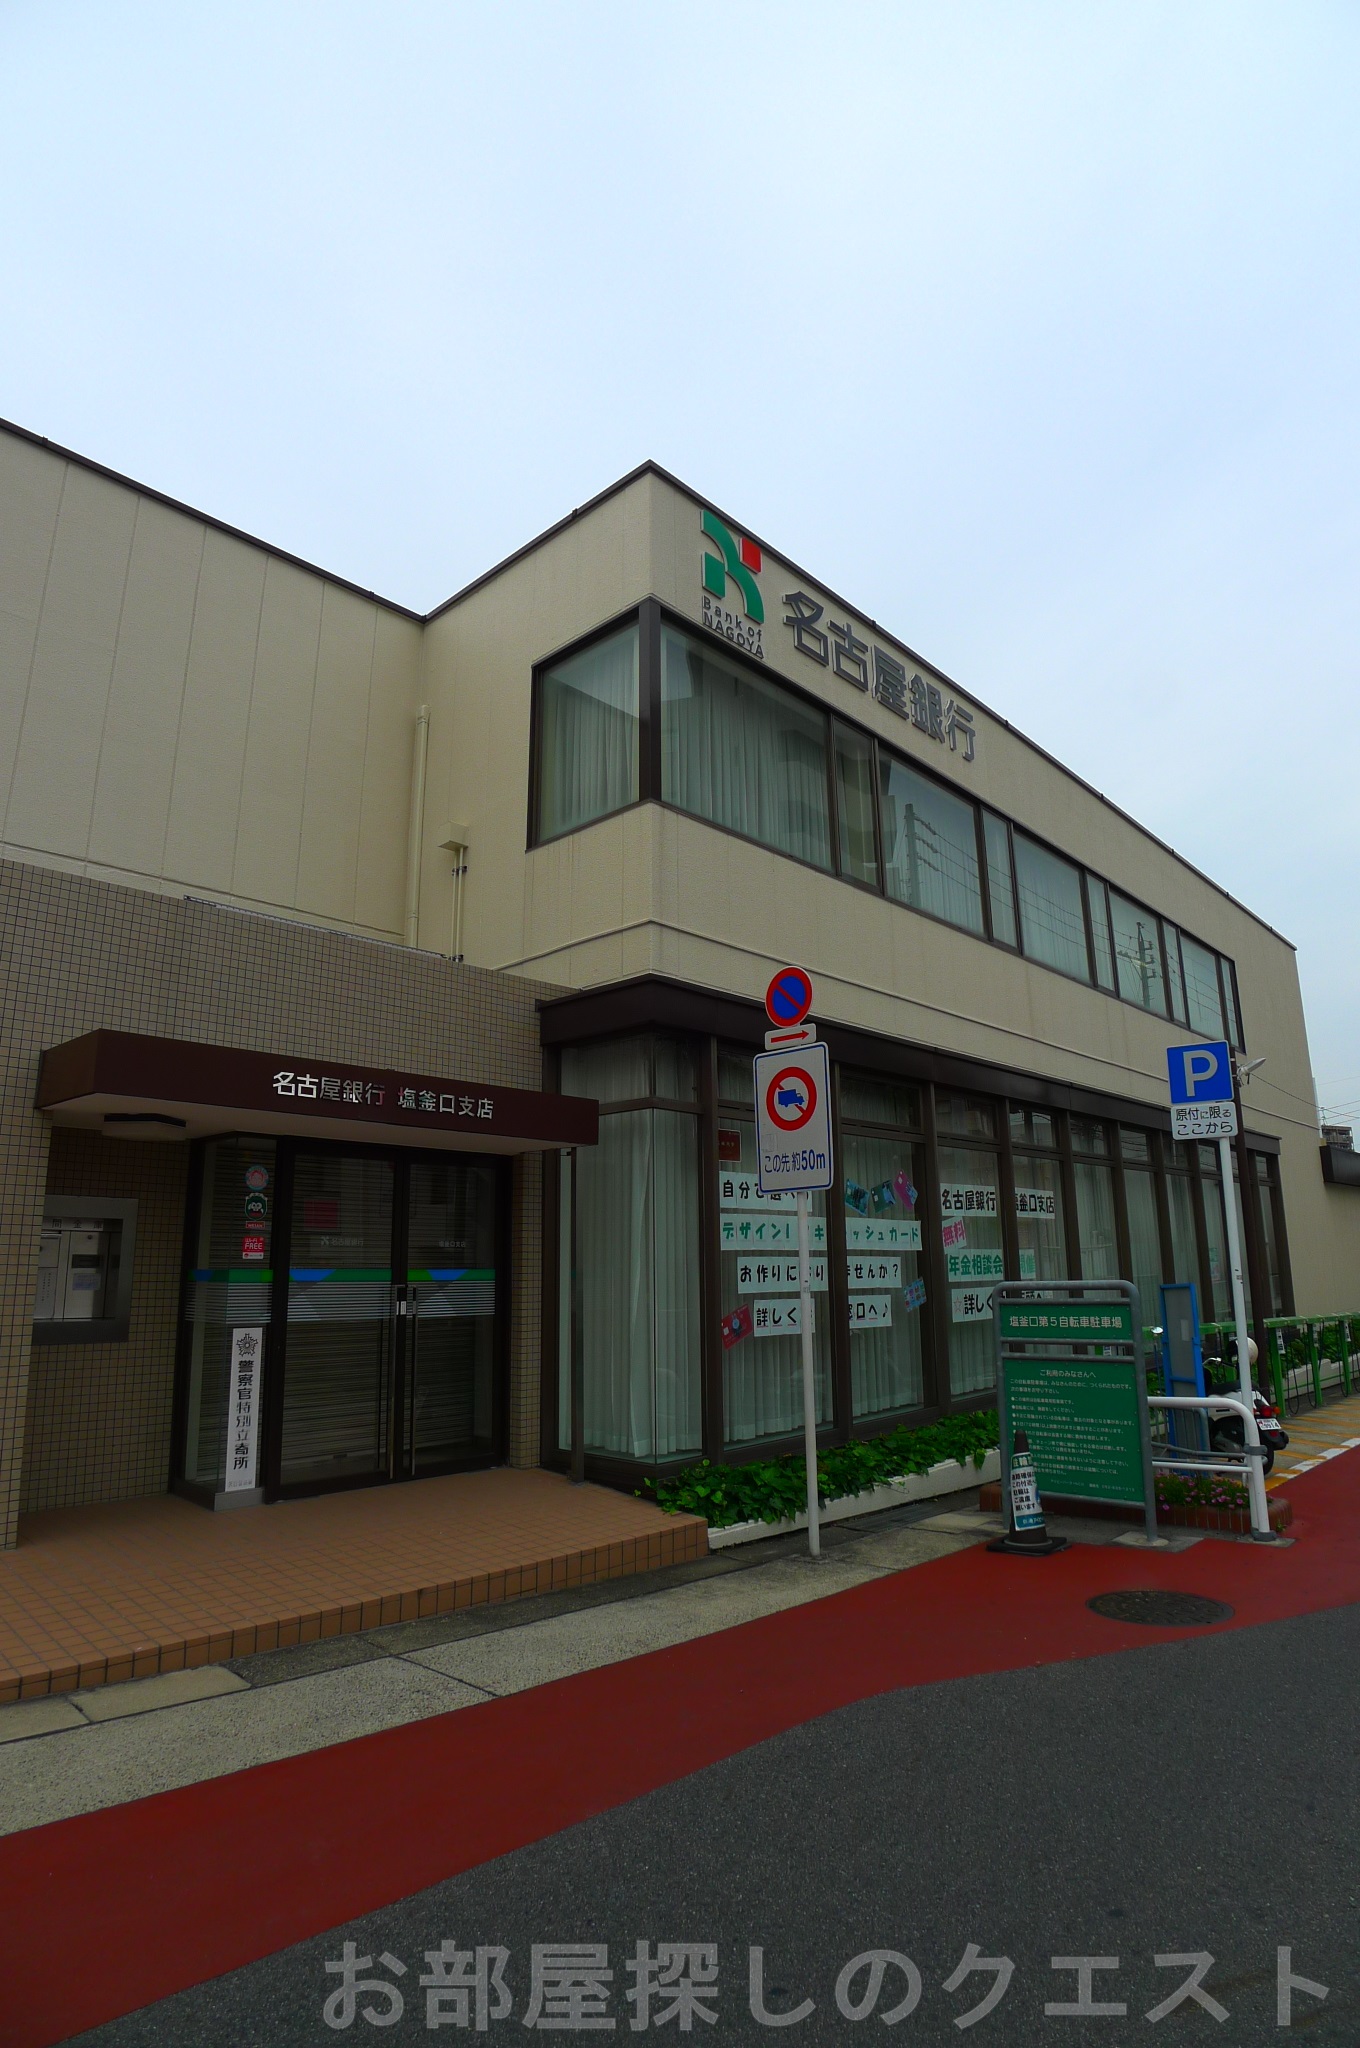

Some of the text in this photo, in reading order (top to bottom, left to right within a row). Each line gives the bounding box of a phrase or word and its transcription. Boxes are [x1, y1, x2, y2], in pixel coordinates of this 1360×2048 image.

[702, 595, 762, 642] Bank of
[702, 611, 764, 660] NAGOYA
[783, 591, 976, 761] 名古屋銀行
[1183, 1050, 1218, 1097] P
[272, 1071, 494, 1119] 名古屋銀行 塩釜口支店
[1175, 1105, 1231, 1121] 原付に限る
[1177, 1121, 1233, 1136] ここから
[764, 1149, 826, 1173] この先約50m
[942, 1188, 996, 1212] 名古屋銀行
[244, 1242, 263, 1250] FREE
[943, 1219, 966, 1248] 無料
[949, 1254, 1003, 1276] 年金相談会
[233, 1360, 254, 1470] 警察官特別立寄所
